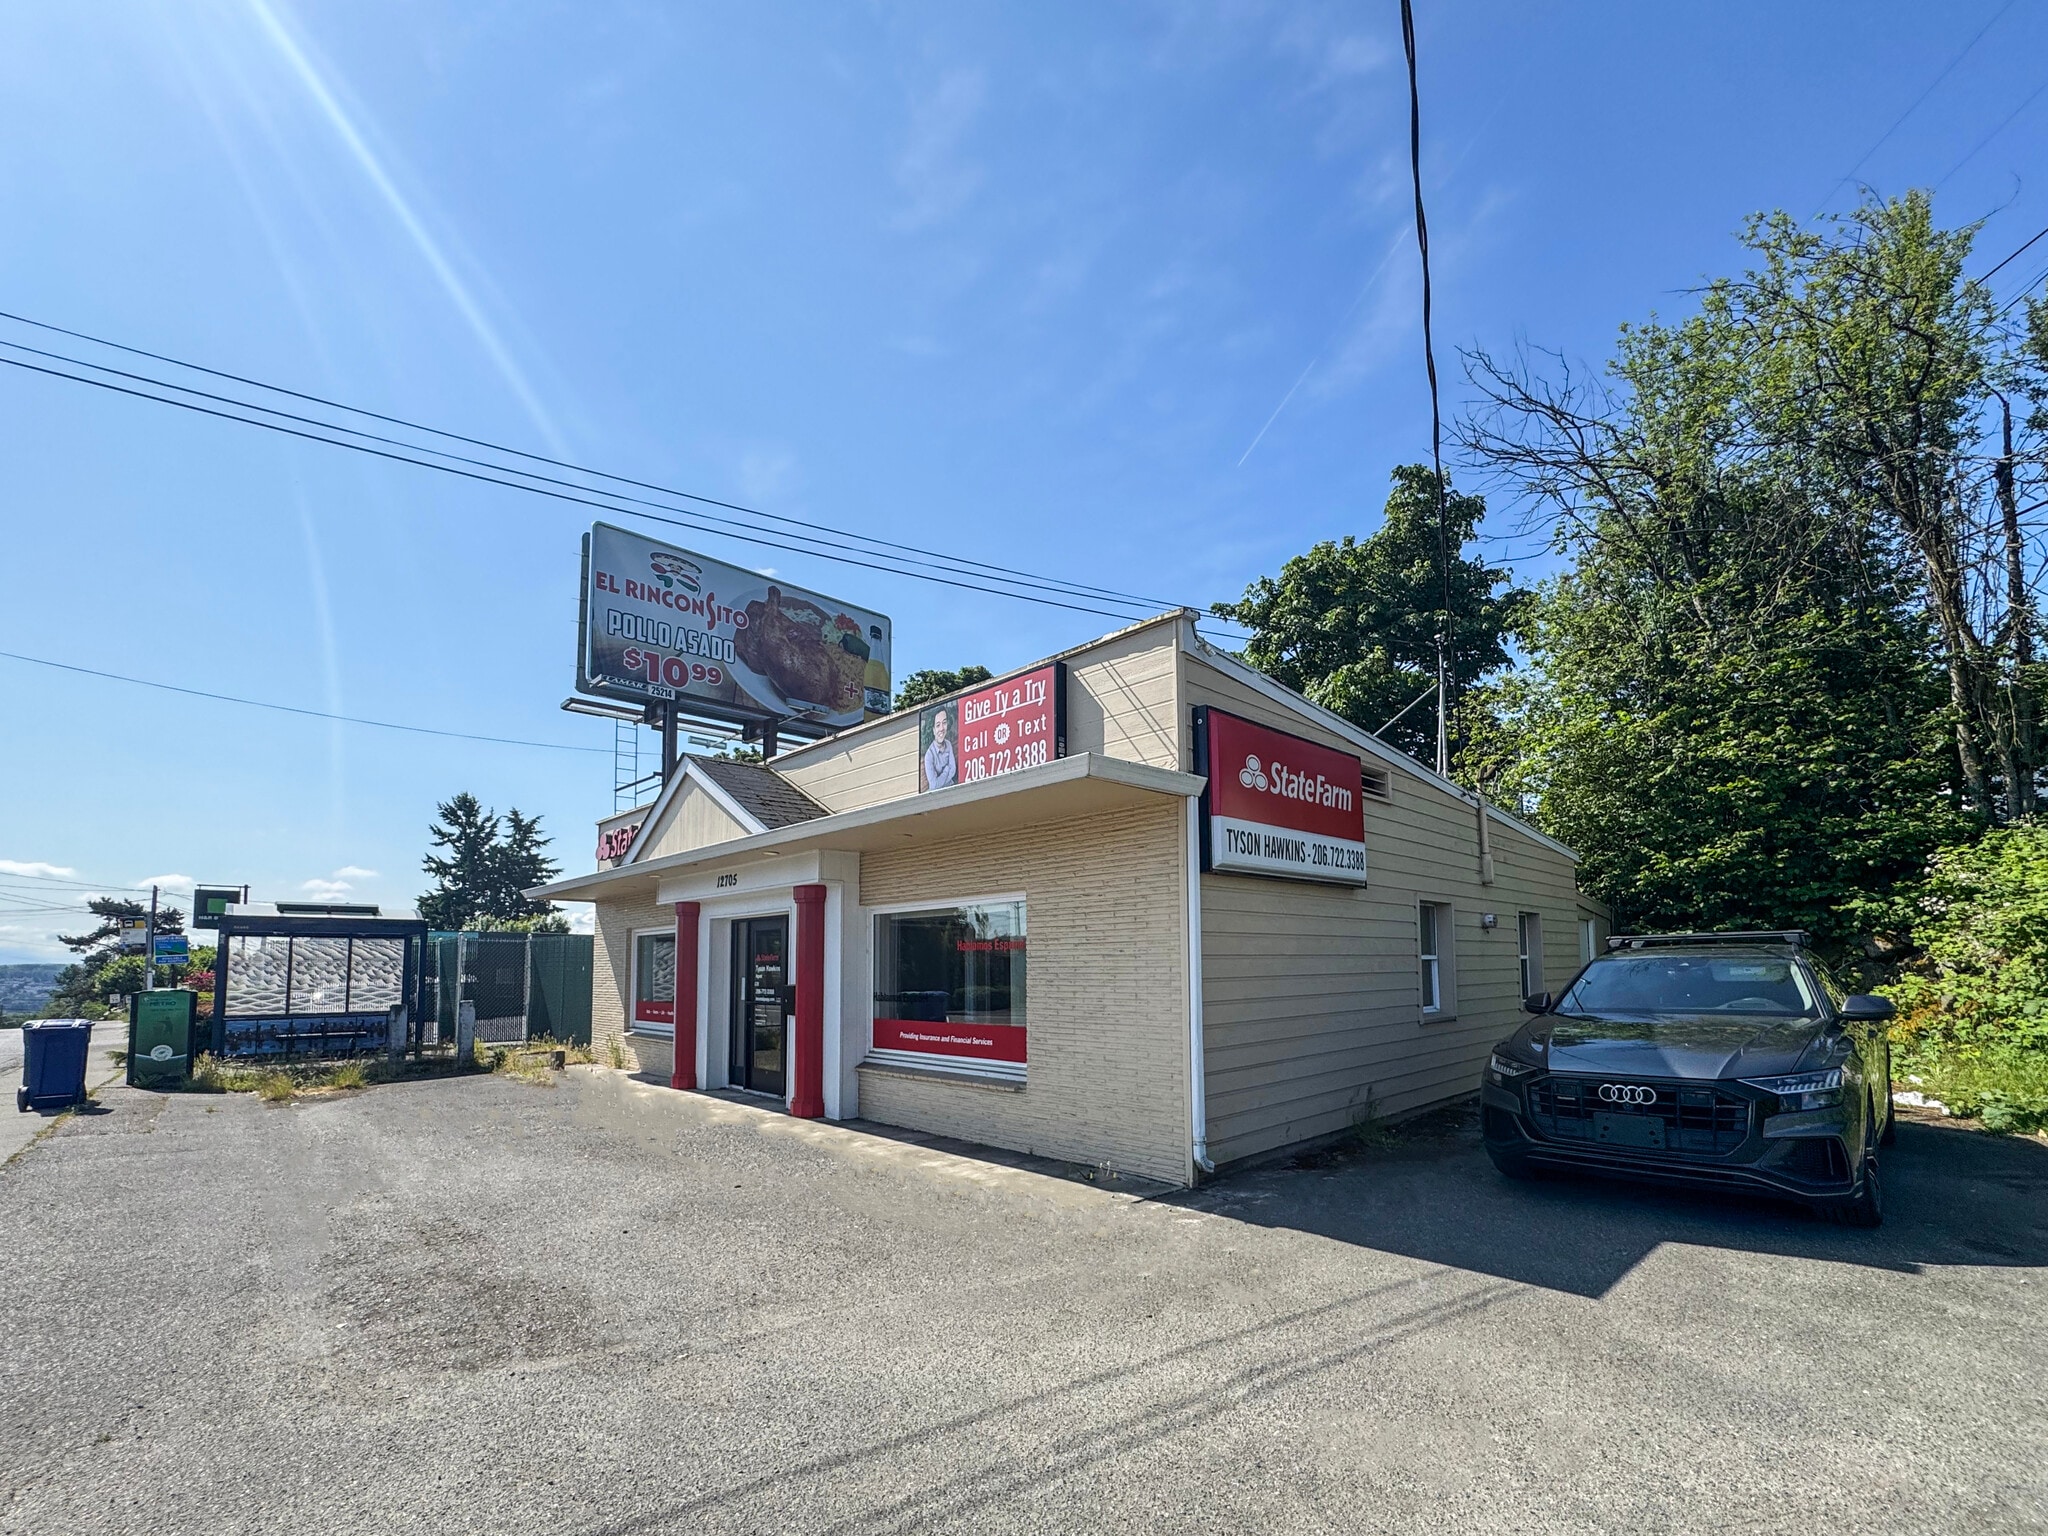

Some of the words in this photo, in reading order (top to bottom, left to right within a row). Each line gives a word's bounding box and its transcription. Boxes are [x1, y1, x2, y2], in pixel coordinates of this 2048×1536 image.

[596, 571, 620, 594] EL
[625, 578, 749, 630] RINCONSITO
[607, 608, 671, 648] POLLO
[674, 627, 735, 664] ASADO
[605, 676, 643, 688] LAMAR
[651, 686, 672, 698] 25214
[965, 699, 990, 721] Give
[994, 690, 1009, 717] Ty
[1012, 689, 1020, 706] a
[1025, 679, 1046, 706] Try
[964, 730, 988, 752] Call
[997, 728, 1007, 740] OR
[1017, 713, 1047, 738] Text
[964, 739, 1047, 783] 206.722.3388
[1226, 828, 1261, 857] TYSON
[1264, 834, 1306, 863] HAWKINS
[1312, 843, 1365, 872] 206.722.3388
[717, 873, 738, 888] 12705
[899, 1031, 919, 1041] Providing
[919, 1033, 940, 1042] Insurance
[941, 1035, 950, 1043] and
[950, 1035, 972, 1044] Financial
[972, 1036, 993, 1046] Services
